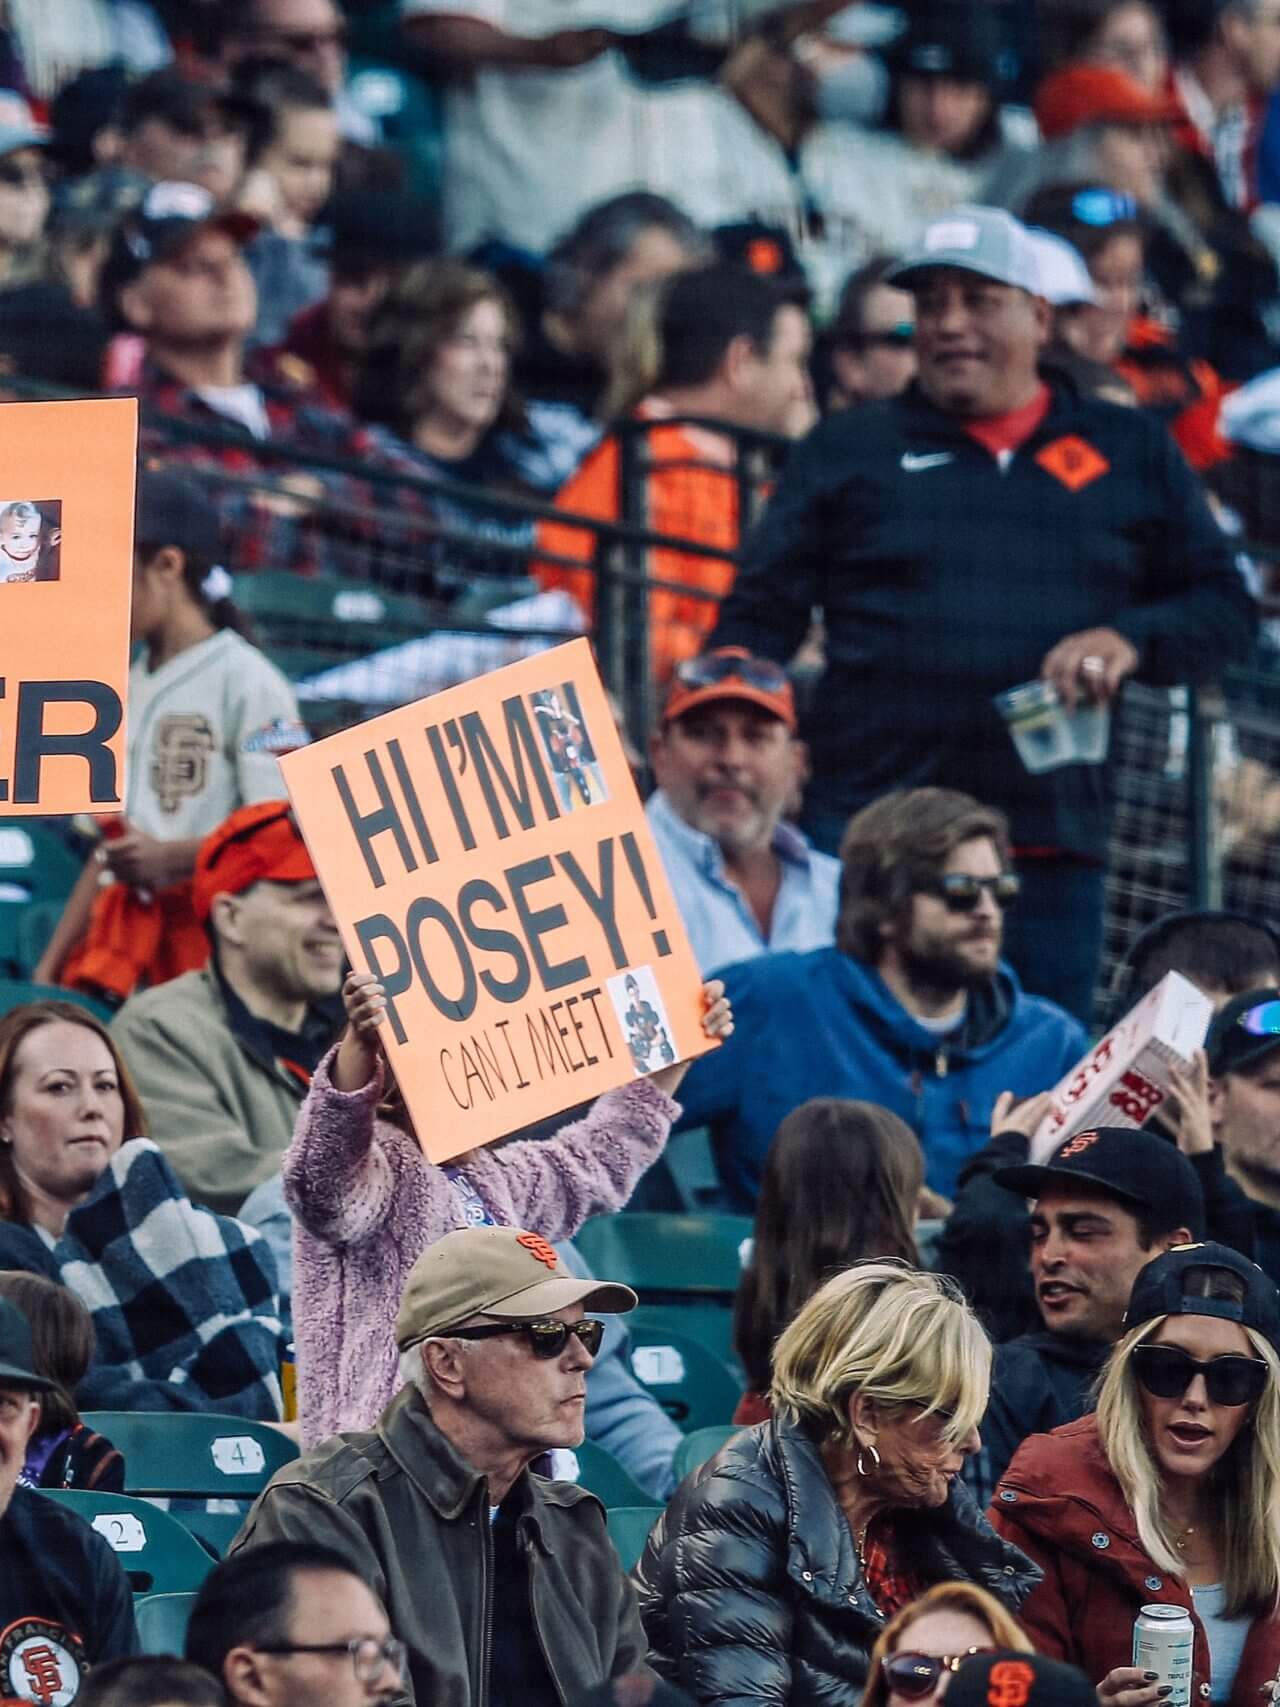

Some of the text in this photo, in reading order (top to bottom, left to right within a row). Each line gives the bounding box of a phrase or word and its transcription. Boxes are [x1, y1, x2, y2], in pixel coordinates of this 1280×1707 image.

[330, 695, 561, 889] HI I'M
[353, 832, 672, 1046] POSEY!
[440, 988, 613, 1110] CAN I MEET
[231, 1442, 246, 1466] 4
[110, 1520, 129, 1544] 2
